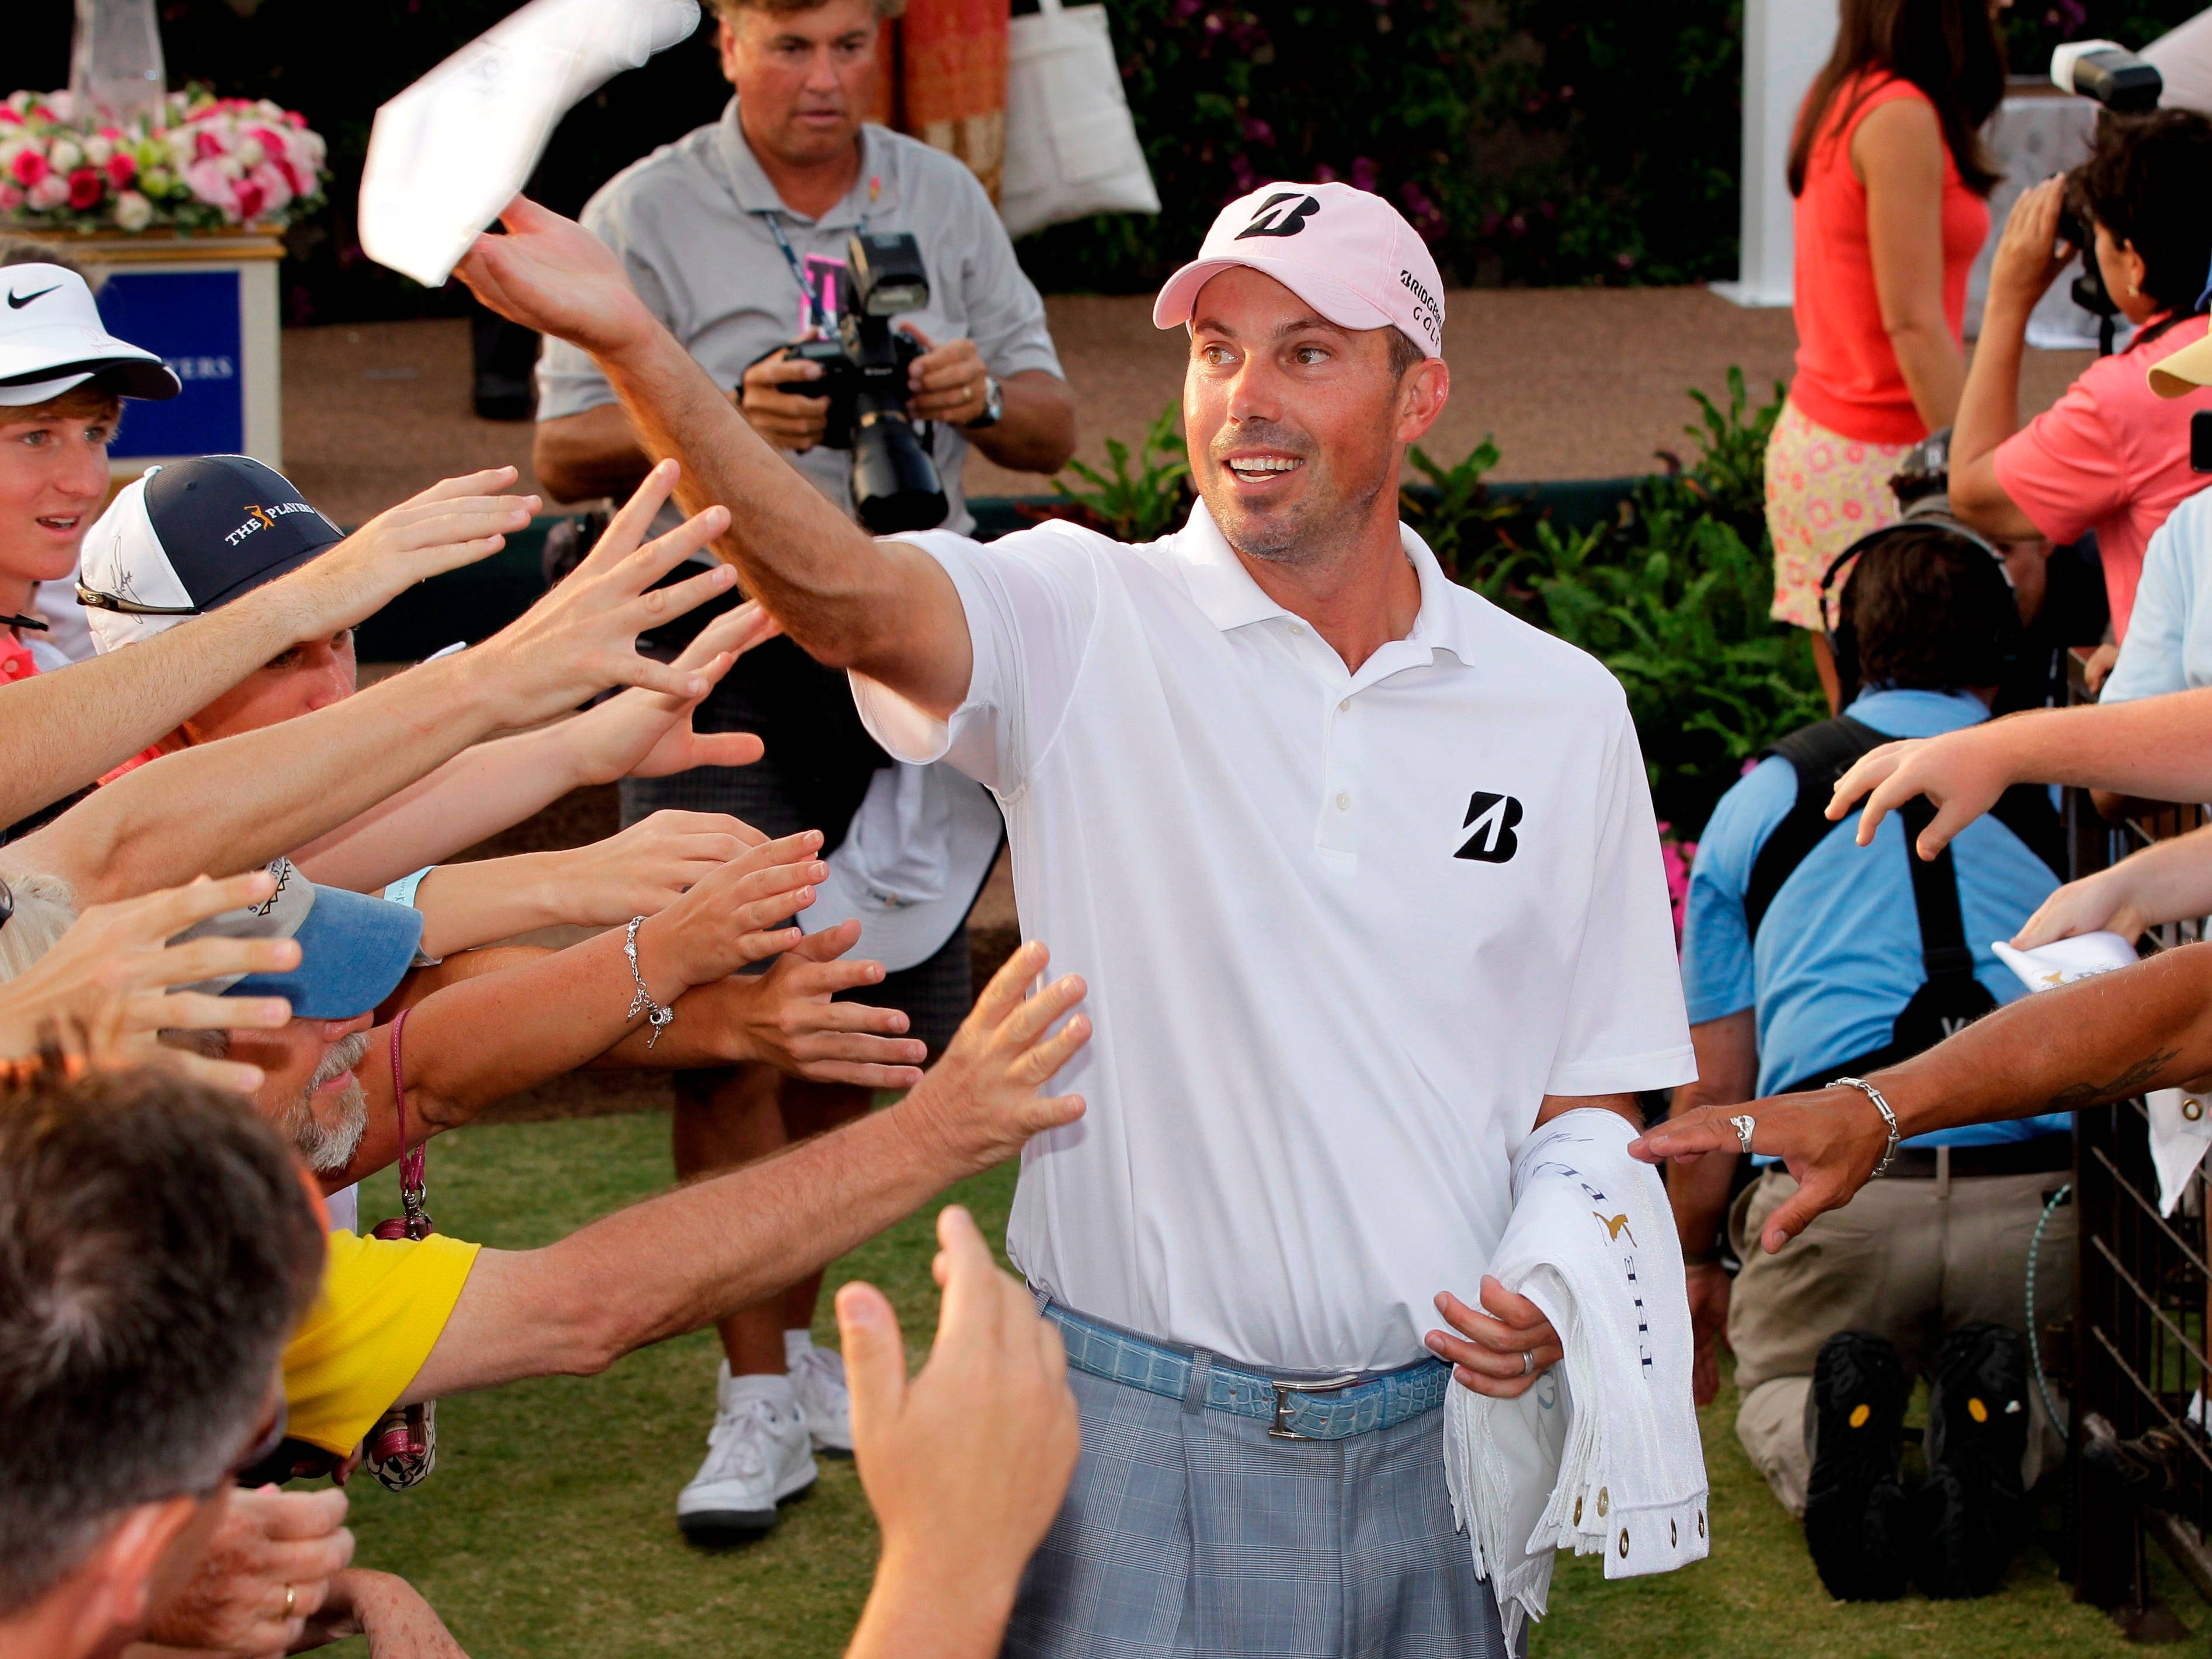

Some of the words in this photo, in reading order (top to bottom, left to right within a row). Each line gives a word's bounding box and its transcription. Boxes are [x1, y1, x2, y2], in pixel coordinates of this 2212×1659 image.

[1413, 306, 1439, 347] GOLF
[224, 517, 262, 546] THE
[1624, 1255, 1653, 1379] THE
